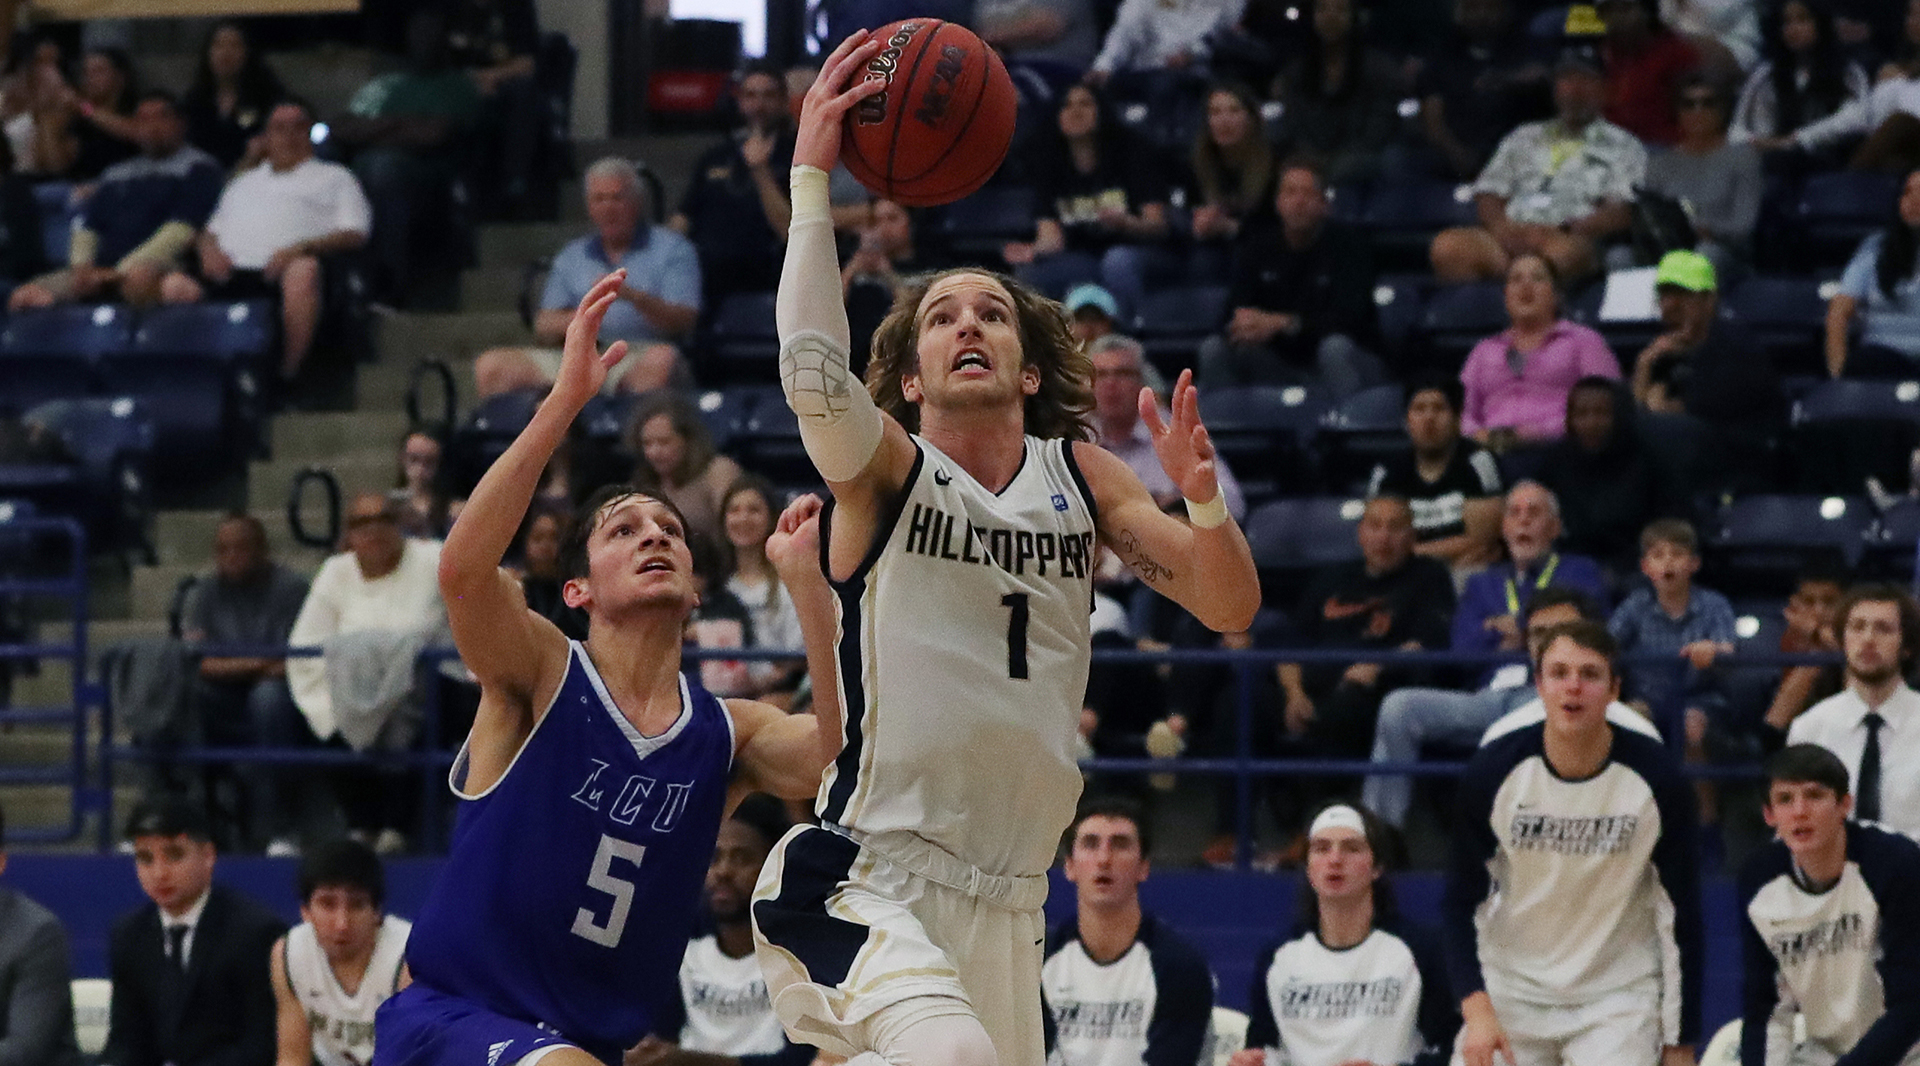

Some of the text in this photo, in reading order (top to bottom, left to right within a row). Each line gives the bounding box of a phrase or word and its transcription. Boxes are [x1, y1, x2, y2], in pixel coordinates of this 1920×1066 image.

[915, 44, 966, 129] NCAA
[1001, 592, 1029, 680] 1
[571, 758, 695, 833] LCU
[570, 833, 646, 948] 5
